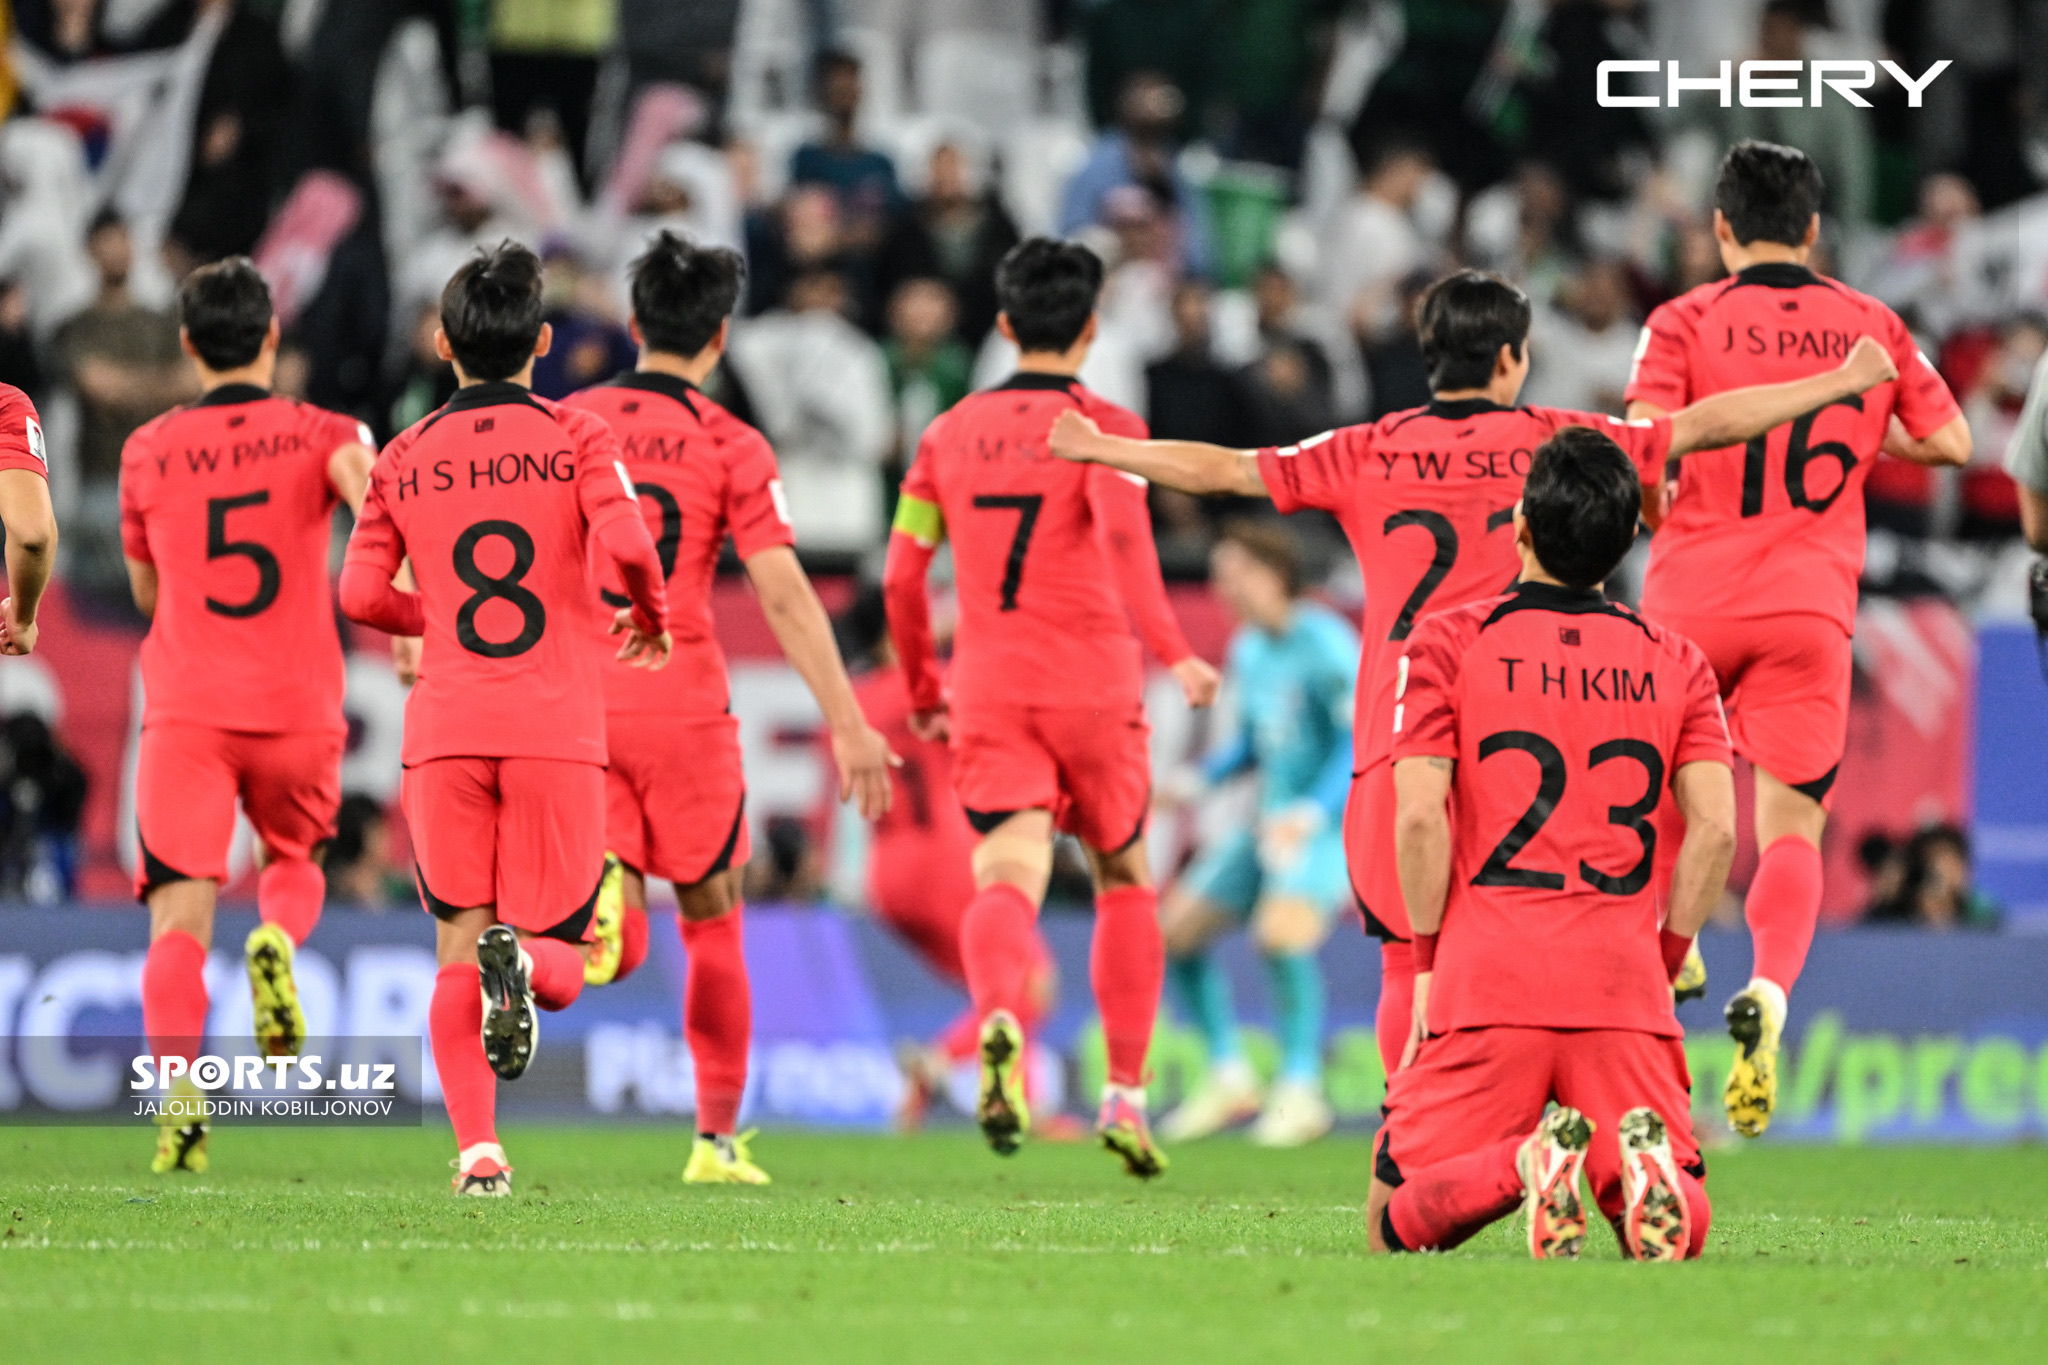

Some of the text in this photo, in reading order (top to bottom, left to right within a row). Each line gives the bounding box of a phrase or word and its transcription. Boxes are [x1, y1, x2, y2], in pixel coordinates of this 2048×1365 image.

[1722, 326, 1734, 353] J
[1747, 325, 1767, 355] S
[157, 452, 169, 477] Y
[186, 448, 220, 473] W
[398, 450, 575, 501] H S HONG
[1378, 448, 1533, 481] Y W SEO
[1740, 393, 1865, 518] 16
[205, 489, 282, 620] 5
[452, 519, 546, 658] 8
[972, 495, 1044, 612] 7
[1498, 657, 1656, 702] T H KIM
[1470, 730, 1665, 896] 23
